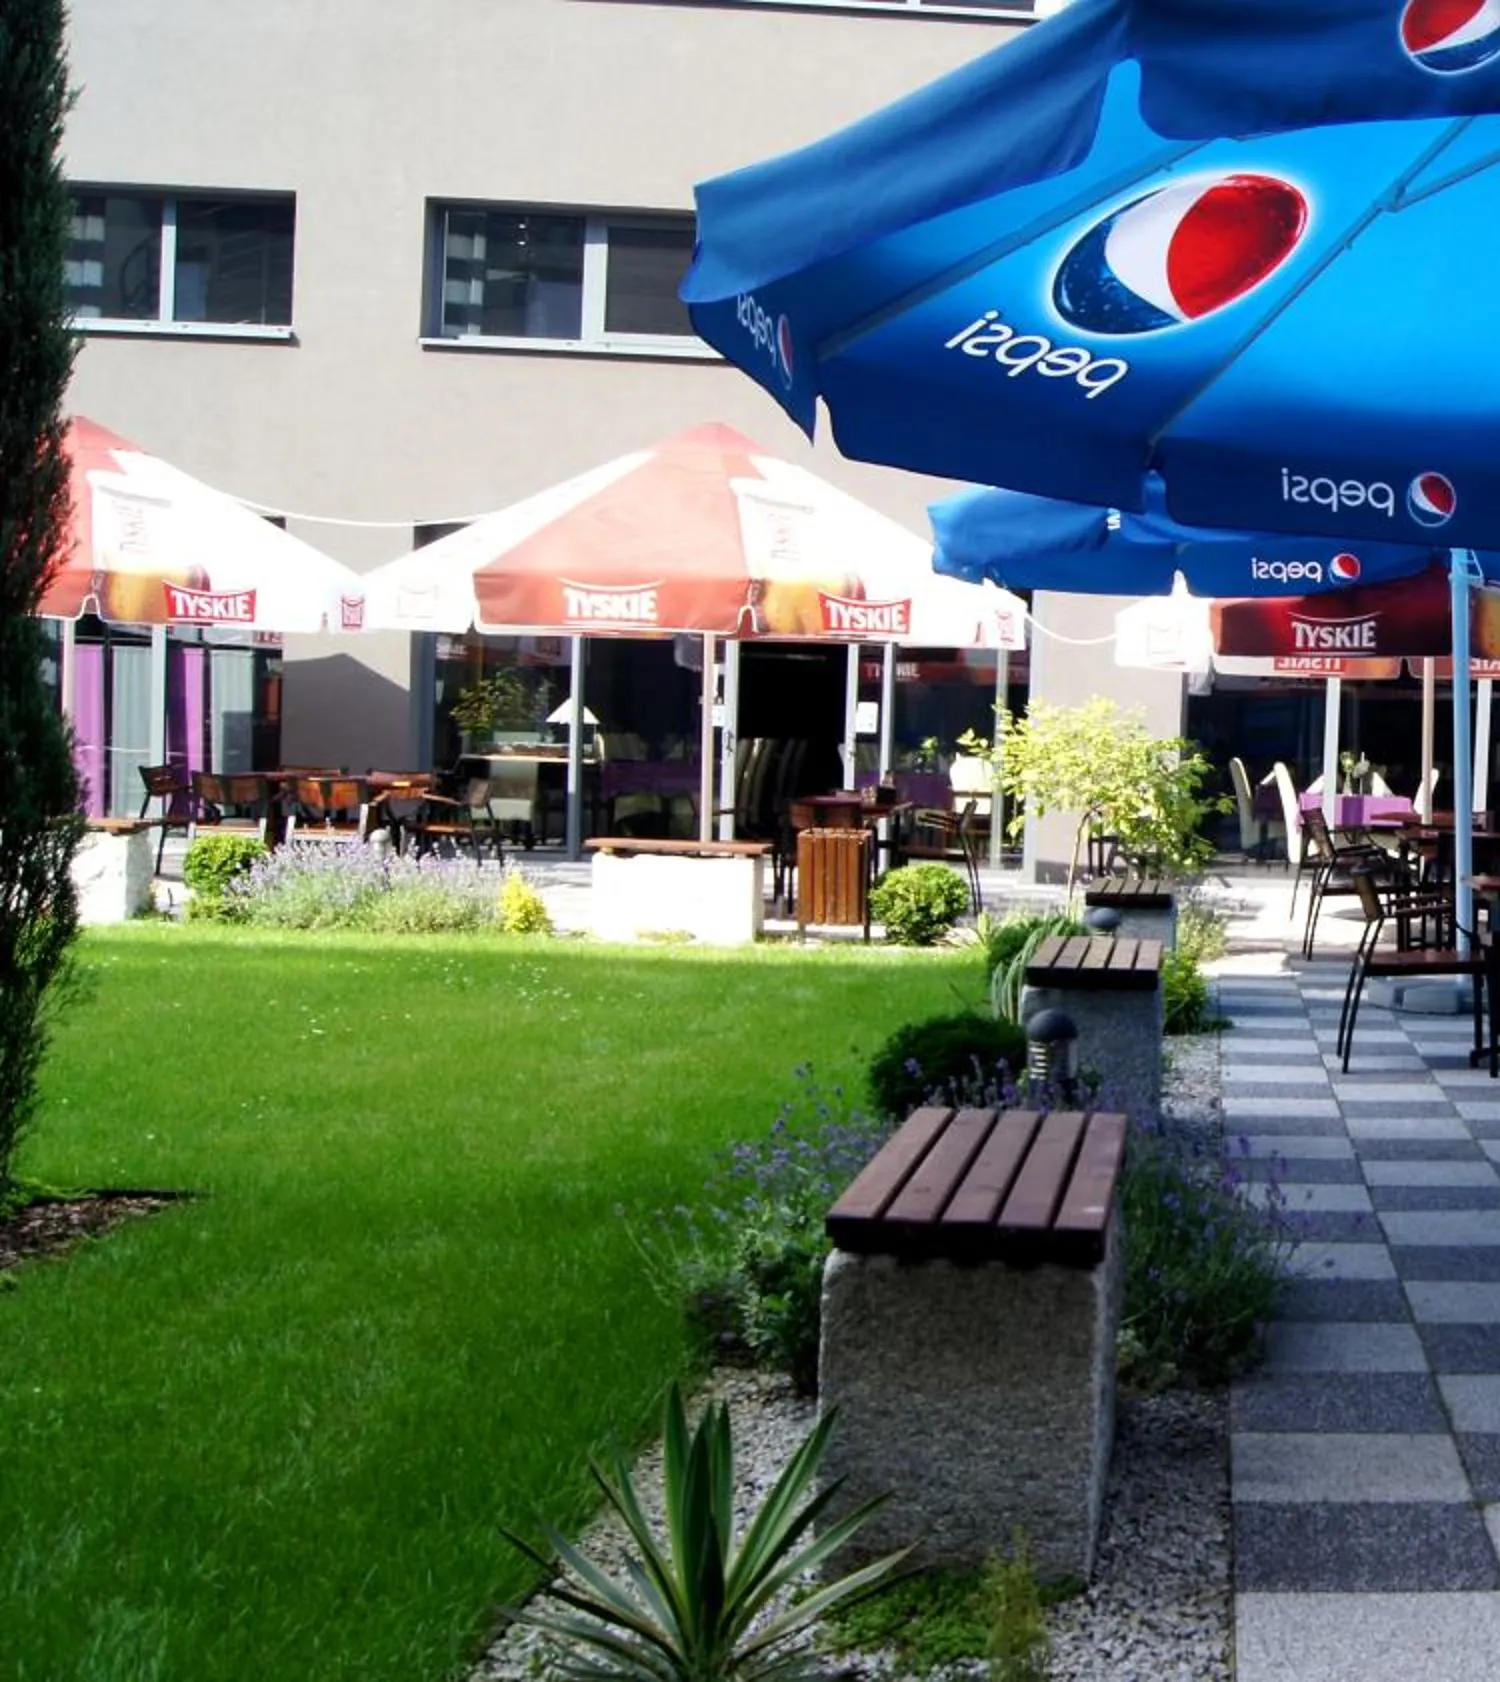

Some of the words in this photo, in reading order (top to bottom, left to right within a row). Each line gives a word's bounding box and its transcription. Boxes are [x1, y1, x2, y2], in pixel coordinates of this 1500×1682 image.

[171, 590, 253, 618] TYSKIE
[562, 587, 659, 620] TYSKIE
[826, 602, 906, 631] TYSKIE
[1291, 621, 1377, 648] TYSKIE
